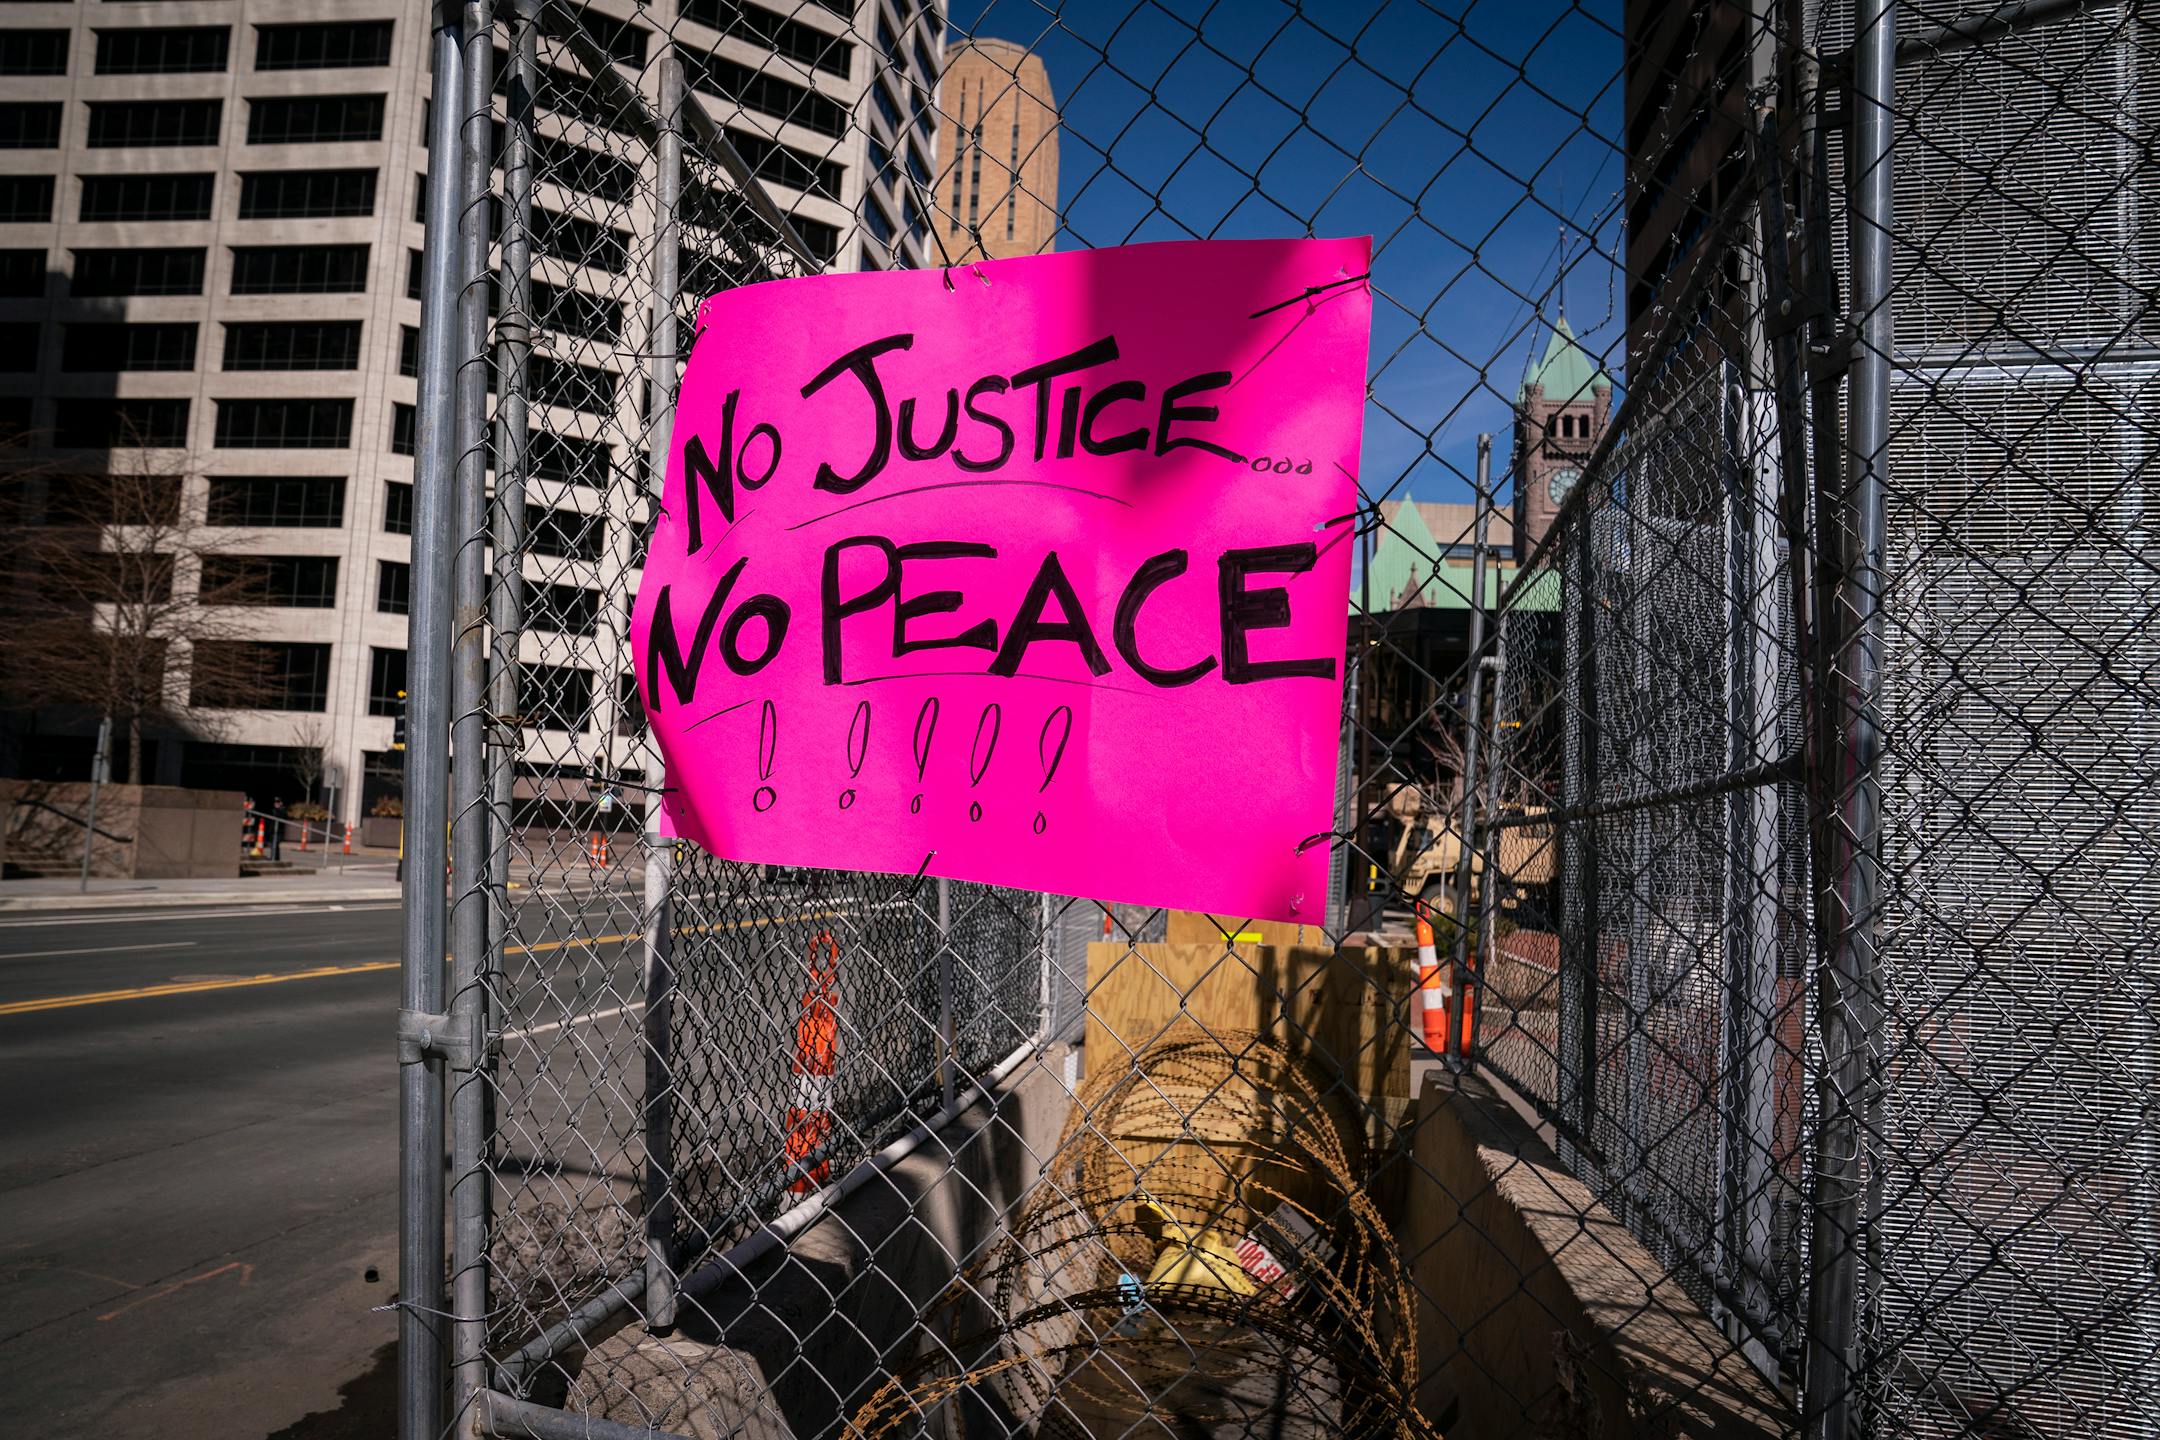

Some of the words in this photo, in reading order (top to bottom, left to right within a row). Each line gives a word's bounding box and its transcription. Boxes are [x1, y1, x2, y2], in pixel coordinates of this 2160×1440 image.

[684, 389, 782, 556] NO
[647, 556, 791, 713] NO
[821, 535, 1336, 688] PEACE
